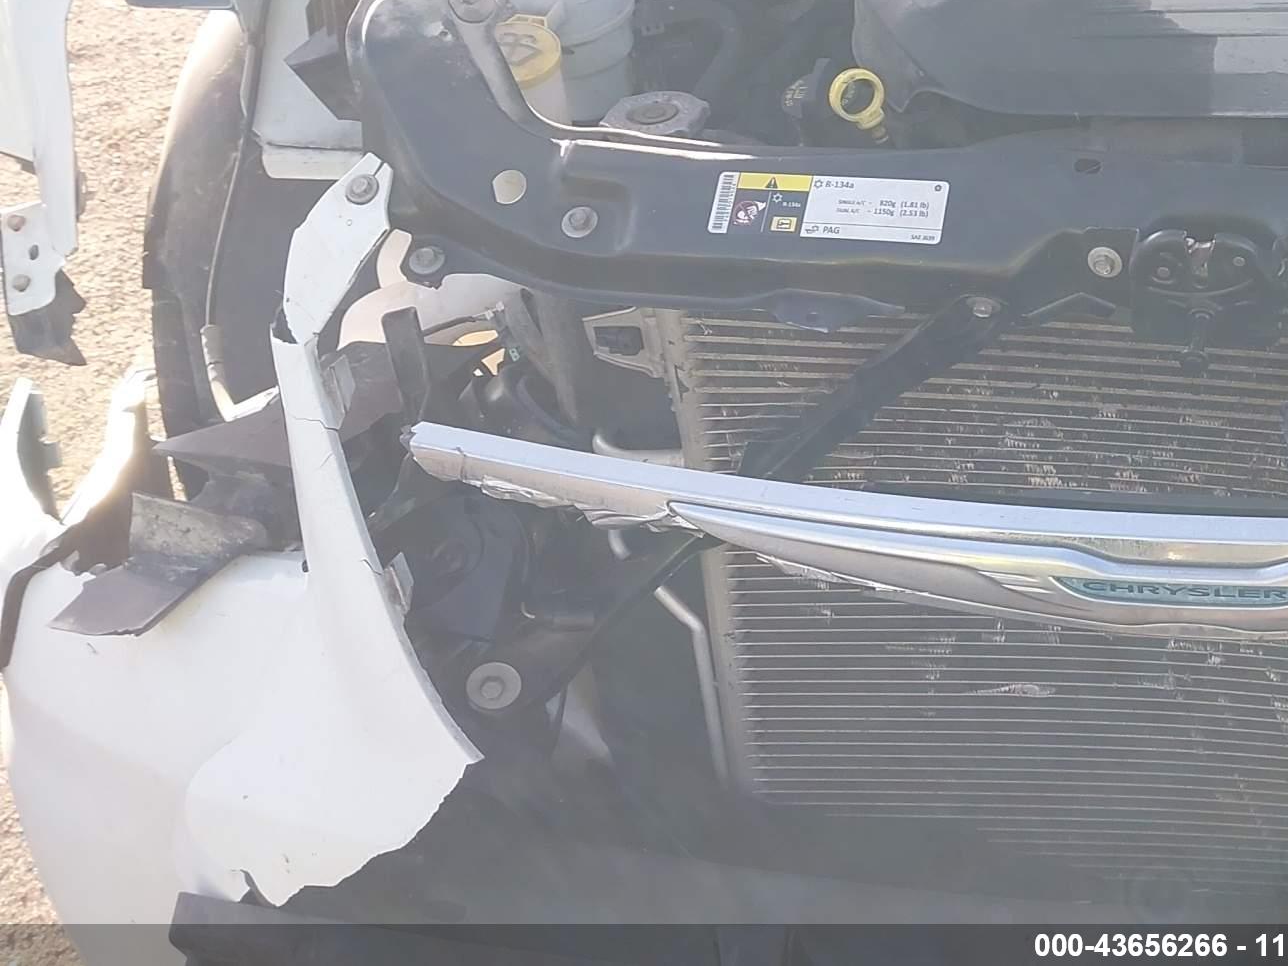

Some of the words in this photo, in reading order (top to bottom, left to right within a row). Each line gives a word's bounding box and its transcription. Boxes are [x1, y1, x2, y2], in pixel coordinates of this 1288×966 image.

[825, 180, 855, 189] R-134a
[880, 199, 897, 208] 820g
[919, 202, 929, 210] lb)
[822, 226, 840, 234] PAG
[1082, 580, 1288, 599] CHRYSLER
